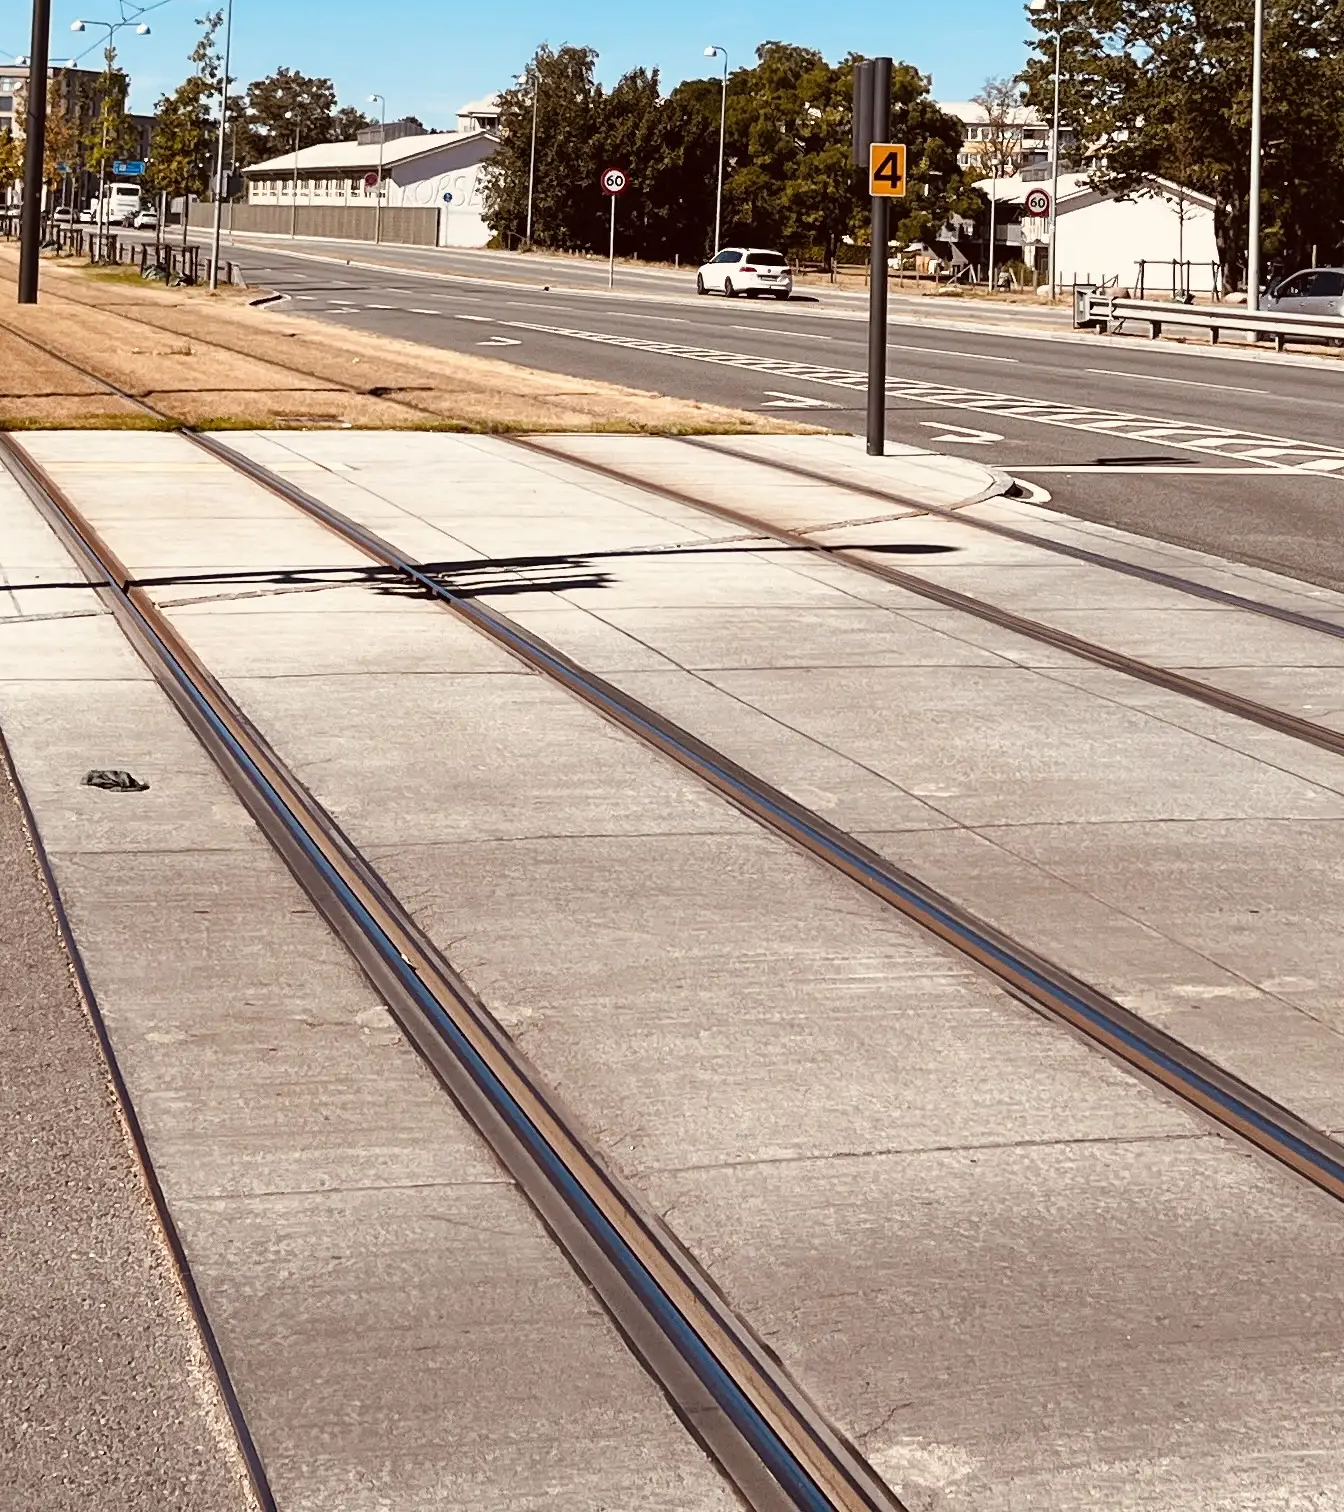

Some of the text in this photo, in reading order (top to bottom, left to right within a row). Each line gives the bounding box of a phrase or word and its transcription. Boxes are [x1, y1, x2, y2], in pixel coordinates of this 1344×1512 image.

[874, 151, 902, 189] 4
[606, 175, 624, 186] 60
[1030, 197, 1045, 208] 60
